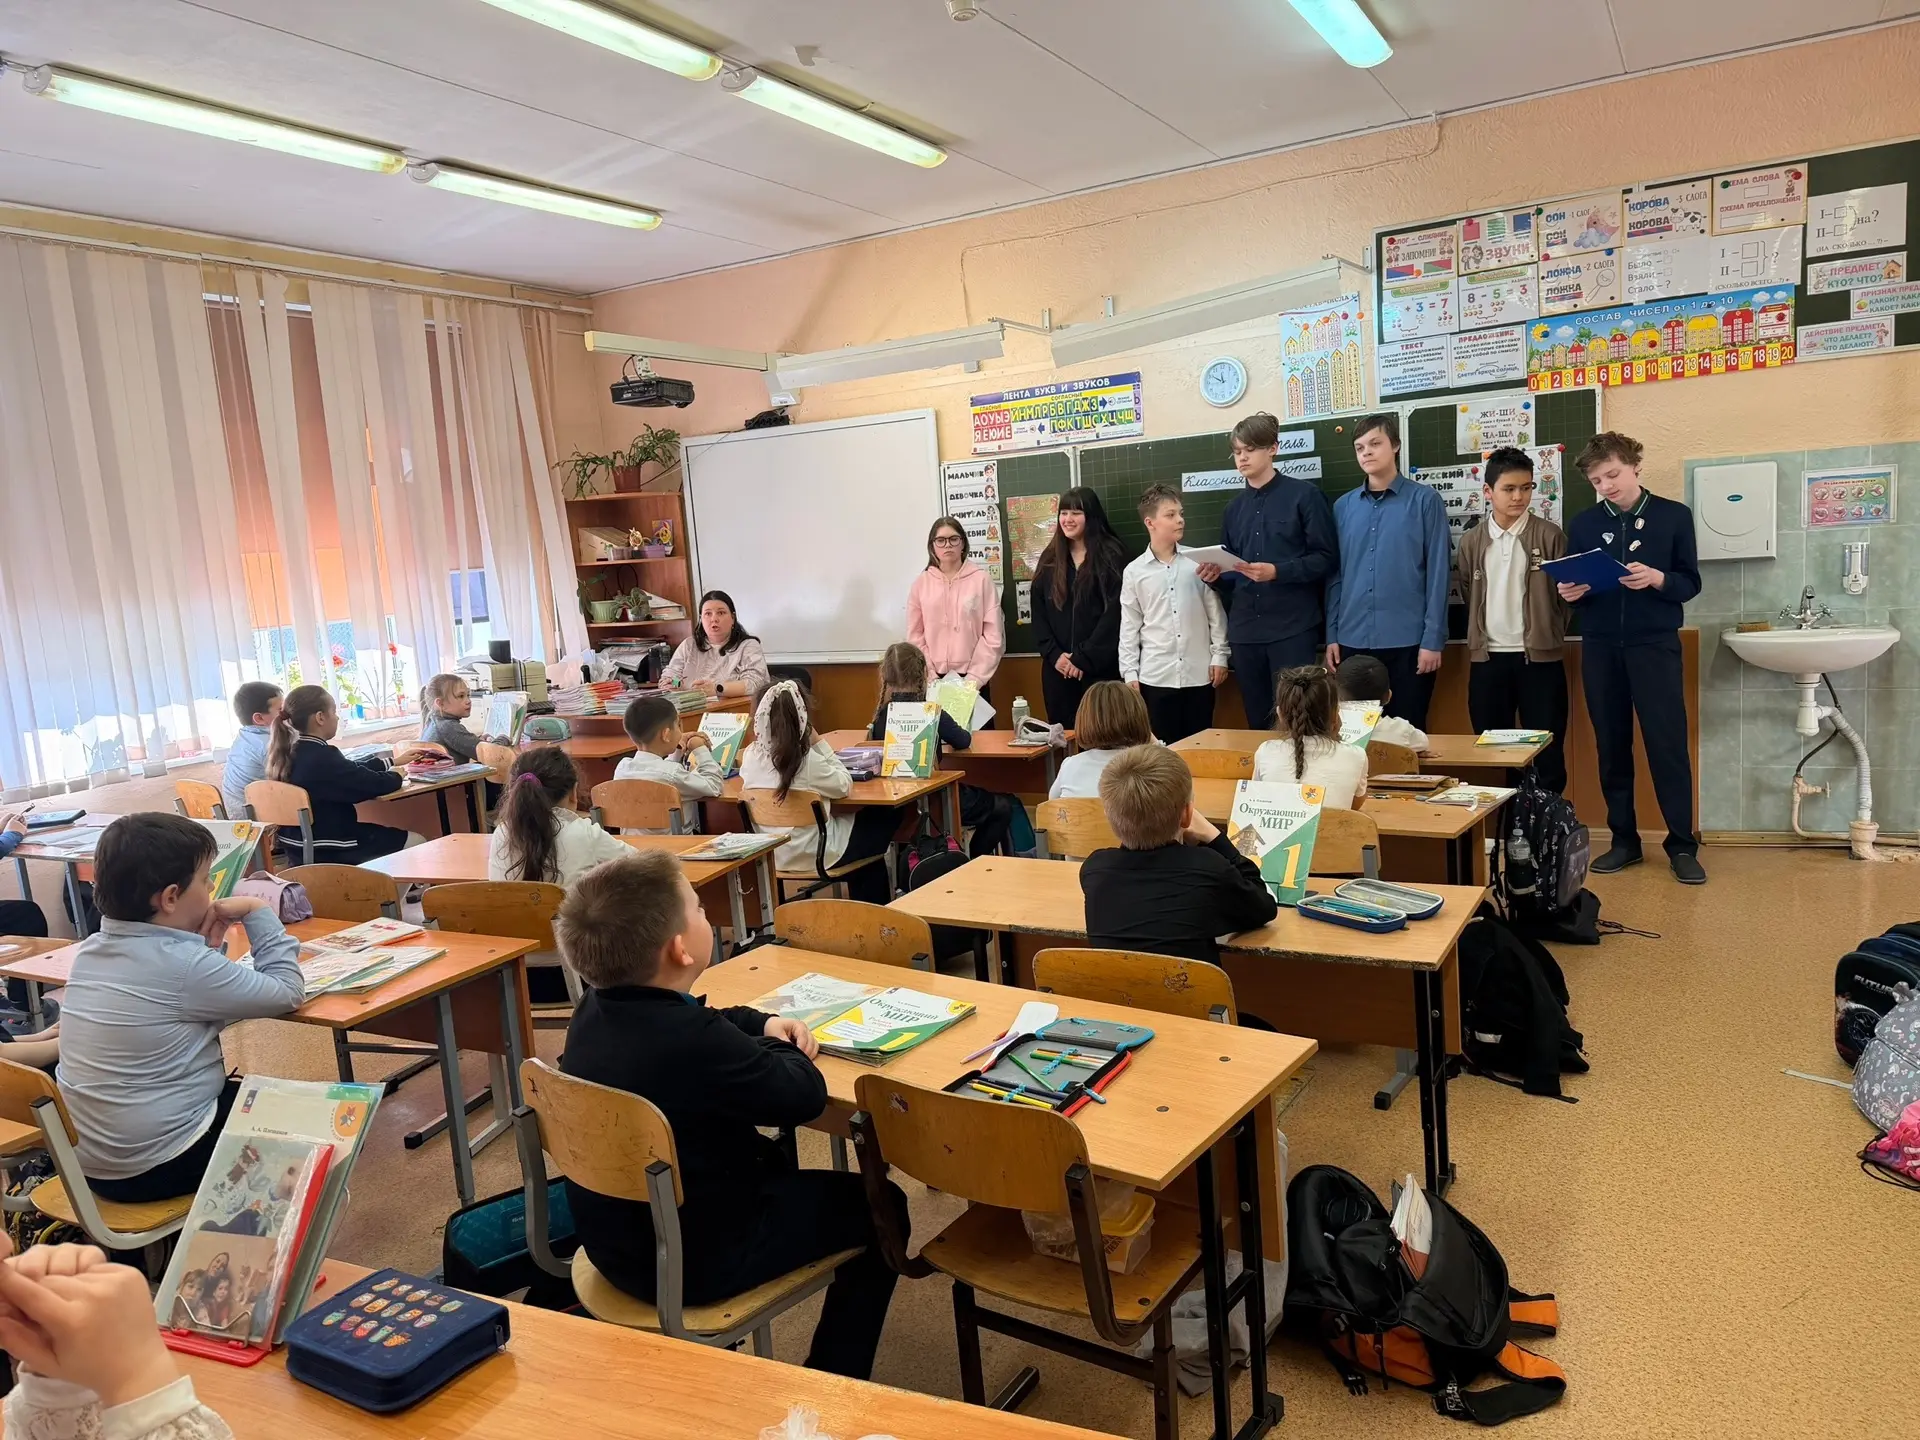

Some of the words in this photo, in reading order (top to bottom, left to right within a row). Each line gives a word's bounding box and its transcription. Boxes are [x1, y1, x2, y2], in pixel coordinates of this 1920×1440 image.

[1752, 173, 1780, 183] СЛОВА
[1628, 197, 1670, 212] КОРОВА
[1686, 191, 1707, 202] СЛОГА
[1720, 203, 1744, 212] СХЕМА
[1546, 212, 1566, 223] СОН
[1576, 209, 1590, 217] СЛОГ
[1628, 216, 1670, 230] КОРОВА
[1546, 230, 1566, 241] СОН
[1546, 265, 1582, 278] ЛОЖКА
[1594, 260, 1615, 269] СЛОГА
[1830, 262, 1881, 276] ПРЕДМЕТ
[1828, 278, 1854, 288] КТО?
[1856, 274, 1883, 284] ЧТО?
[1468, 293, 1475, 303] 8
[1493, 289, 1500, 299] 5
[1520, 284, 1527, 295] 3
[1546, 284, 1582, 296] ЛОЖКА
[1628, 284, 1654, 294] Стало
[1861, 289, 1897, 297] ПРИЗНАК
[1899, 284, 1920, 292] ПРЕД
[1416, 302, 1423, 312] 3
[1441, 298, 1448, 308] 7
[1869, 296, 1899, 305] КАКОЙ?
[1575, 313, 1621, 325] СОСТАВ
[1629, 305, 1669, 317] ЧИСЕЛ
[1870, 304, 1899, 313] КАКОЕ?
[1805, 327, 1843, 339] ДЕЙСТВИЕ
[1846, 323, 1885, 333] ПРЕДМЕТА
[1840, 332, 1872, 341] ДЕЛАЕТ?
[1400, 342, 1424, 350] ТЕКСТ
[1839, 341, 1874, 350] ДЕЛАЮТ?
[1530, 378, 1537, 389] 0
[1553, 375, 1560, 387] 2
[1564, 373, 1572, 385] 3
[1576, 372, 1584, 384] 4
[1588, 370, 1596, 383] 5
[1600, 369, 1607, 381] 6
[1612, 367, 1619, 379] 7
[1623, 366, 1631, 378] 8
[1635, 365, 1643, 377] 9
[1647, 362, 1657, 375] 10
[1660, 362, 1670, 374] 11
[1672, 360, 1684, 372] 12
[1685, 358, 1697, 371] 13
[1699, 356, 1710, 369] 14
[1712, 355, 1724, 368] 15
[1726, 353, 1737, 365] 16
[1740, 351, 1751, 364] 17
[1754, 349, 1766, 362] 18
[1767, 348, 1779, 361] 19
[1782, 346, 1793, 359] 20
[1002, 390, 1030, 401] ЛЕНТА
[1034, 385, 1056, 396] БУКВ
[1060, 384, 1068, 392] И
[1073, 377, 1110, 390] ЗВУКОВ
[1051, 392, 1083, 401] СОГЛАСНЫЕ
[1480, 408, 1516, 418] ЖИ-ШИ
[1483, 430, 1514, 439] ЧА-ЩА
[947, 470, 984, 481] МАЛЬЧИК
[1183, 475, 1246, 488] Классная
[1280, 460, 1320, 474] бота.
[1415, 469, 1464, 481] РУССКИЙ
[949, 490, 984, 501] ДЕВОЧКА
[721, 743, 731, 767] 1
[917, 738, 928, 766] 1
[1240, 803, 1307, 819] Окружающий
[1259, 817, 1294, 830] МИР
[1279, 843, 1302, 889] 1
[1854, 974, 1894, 993] FUTUR
[869, 998, 939, 1020] Окружающий
[880, 1010, 921, 1024] МИР
